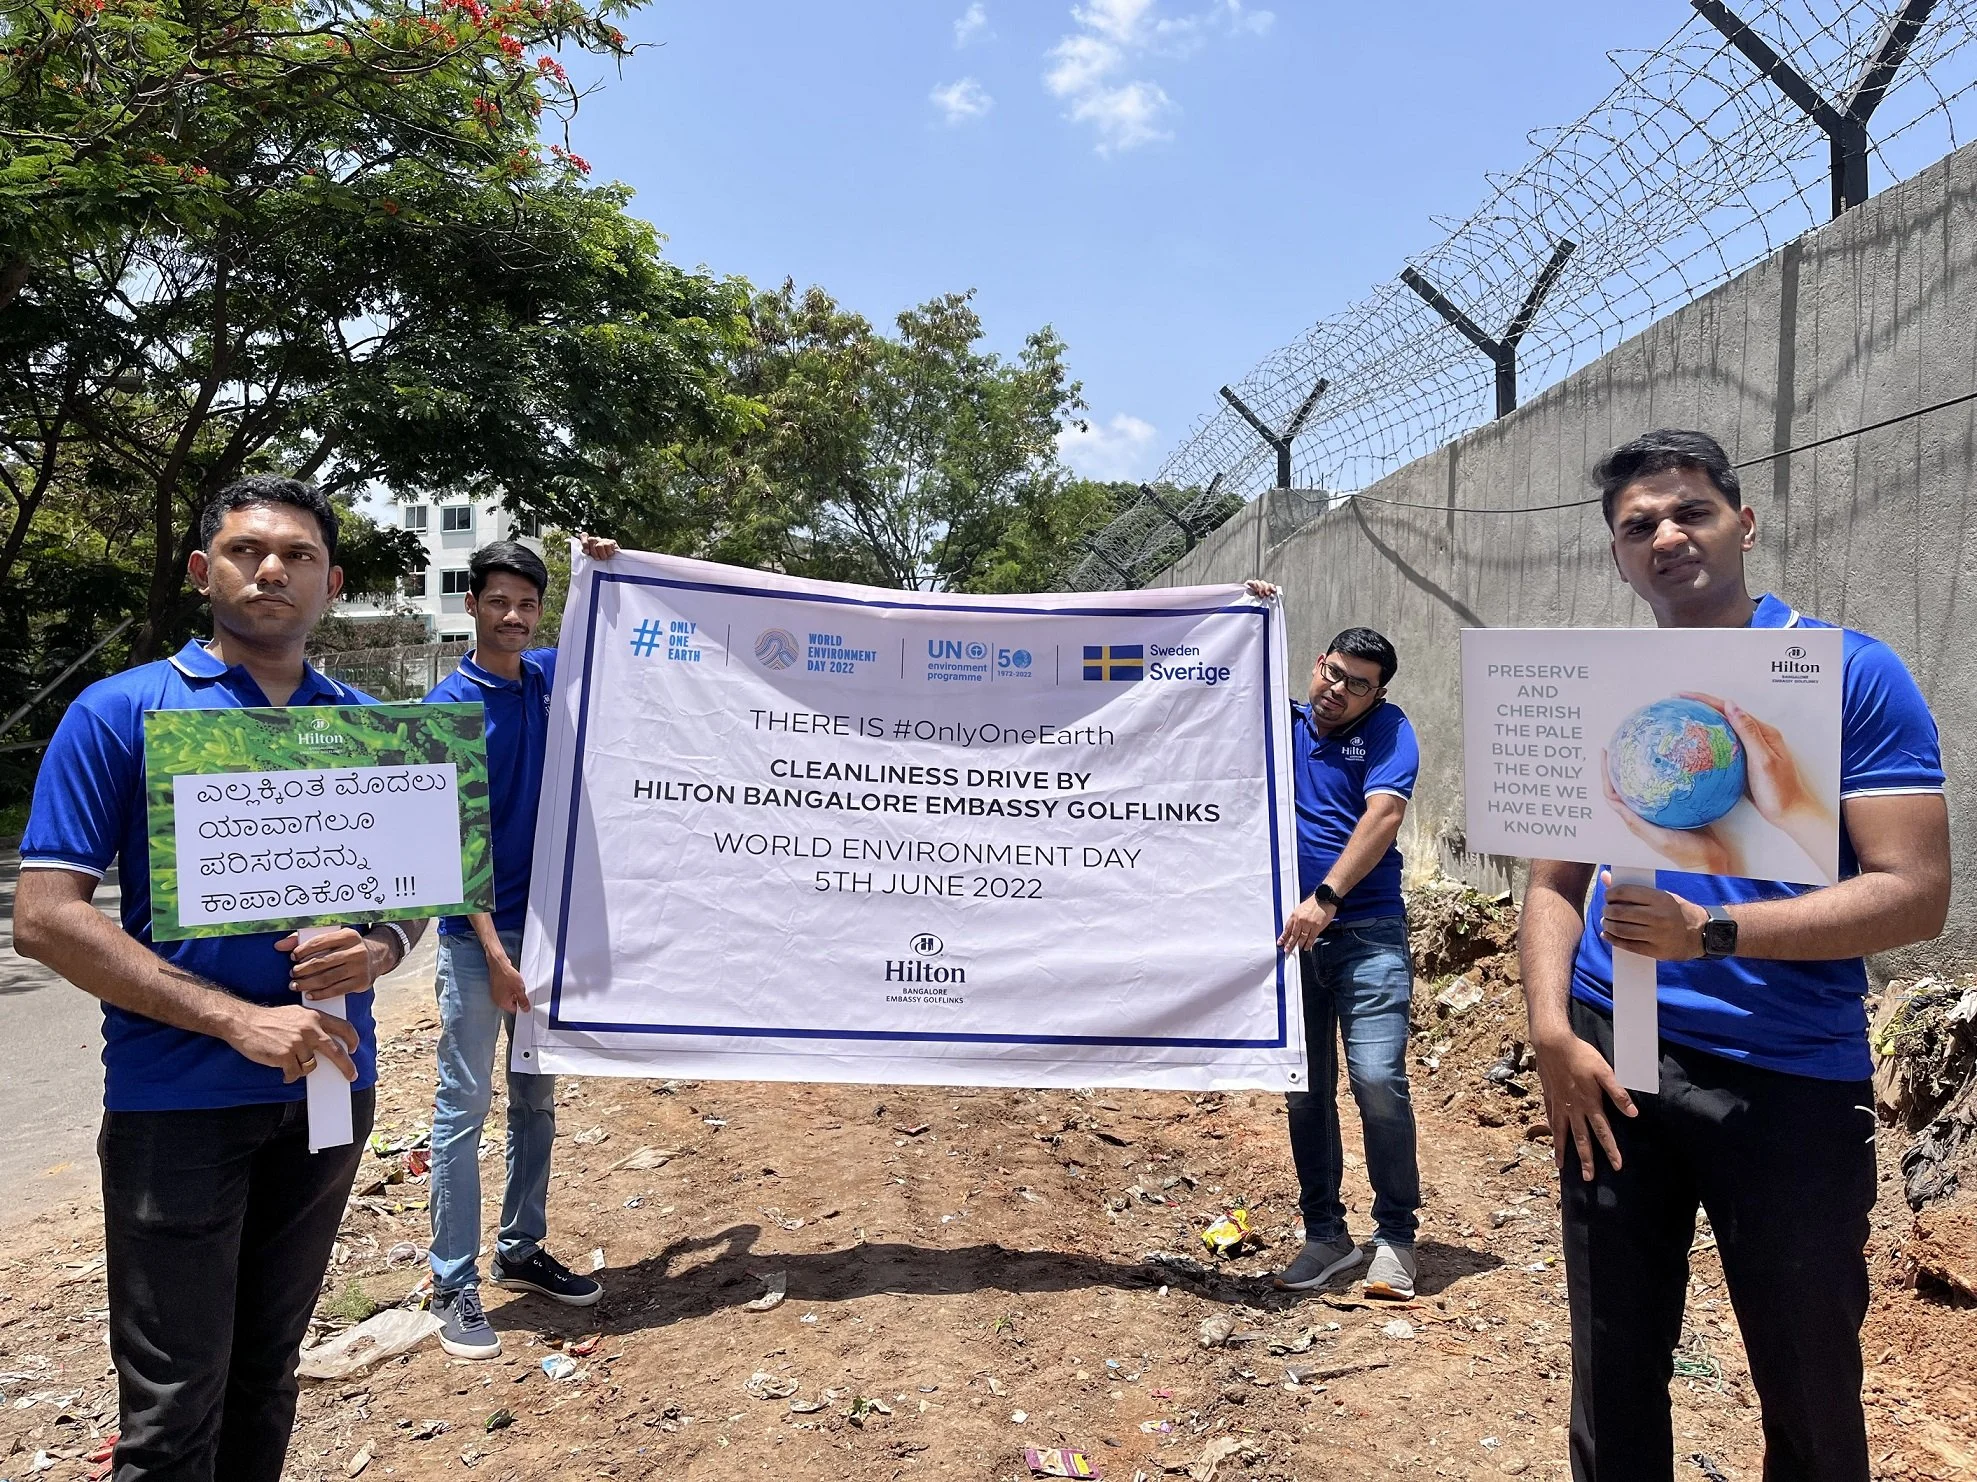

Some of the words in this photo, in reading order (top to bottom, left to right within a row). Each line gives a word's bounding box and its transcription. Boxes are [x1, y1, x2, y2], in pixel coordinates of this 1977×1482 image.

[670, 621, 696, 634] ONLY
[669, 635, 688, 647] ONE
[808, 634, 842, 646] WORLD
[668, 649, 700, 662] EARTH
[808, 648, 876, 662] ENVIRONMENT
[928, 640, 961, 659] UN
[1150, 645, 1199, 656] Sweden
[808, 660, 828, 672] DAY
[830, 661, 854, 674] 2022
[928, 662, 987, 672] environment
[1150, 662, 1230, 685] Sverige
[1488, 665, 1589, 679] PRESERVE
[1771, 661, 1820, 673] Hilton
[928, 673, 982, 682] programme
[1518, 685, 1558, 698] AND
[1497, 704, 1580, 719] CHERISH
[750, 709, 849, 737] THERE
[859, 716, 885, 738] IS
[893, 719, 1114, 747] #OnlyOneEarth
[1495, 724, 1529, 738] THE
[1536, 726, 1582, 739] PALE
[298, 732, 344, 744] Hilton
[1341, 746, 1366, 755] Hilto
[1492, 742, 1539, 757] BLUE
[1545, 745, 1586, 762] DOT,
[770, 759, 959, 787] CLEANLINESS
[967, 769, 1049, 790] DRIVE
[1057, 773, 1091, 791] BY
[1494, 762, 1529, 776] THE
[1535, 764, 1582, 779] ONLY
[197, 775, 325, 805] ಎಲ್ಲಕ್ಕಿಂತ
[335, 771, 446, 795] ಮೊದಲು
[1494, 781, 1550, 797] HOME
[1556, 785, 1588, 799] WE
[633, 779, 735, 803] HILTON
[743, 787, 917, 814] BANGALORE
[926, 795, 1059, 819] EMBASSY
[1067, 800, 1220, 823] GOLFLINKS
[1488, 801, 1536, 816] HAVE
[1542, 804, 1592, 819] EVER
[199, 810, 375, 839] ಯಾವಾಗಲೂ
[1505, 820, 1577, 837] KNOWN
[713, 832, 832, 859] WORLD
[843, 838, 1073, 867] ENVIRONMENT
[1083, 847, 1142, 869] DAY
[200, 844, 371, 875] ಪರಿಸರವನ್ನು
[201, 876, 385, 912] ಕಾಪಾಡಿಕೊಳ್ಳಿ
[395, 876, 416, 897] !!!
[814, 871, 872, 893] 5TH
[882, 874, 964, 897] JUNE
[973, 877, 1044, 900] 2022
[885, 960, 966, 983] Hilton
